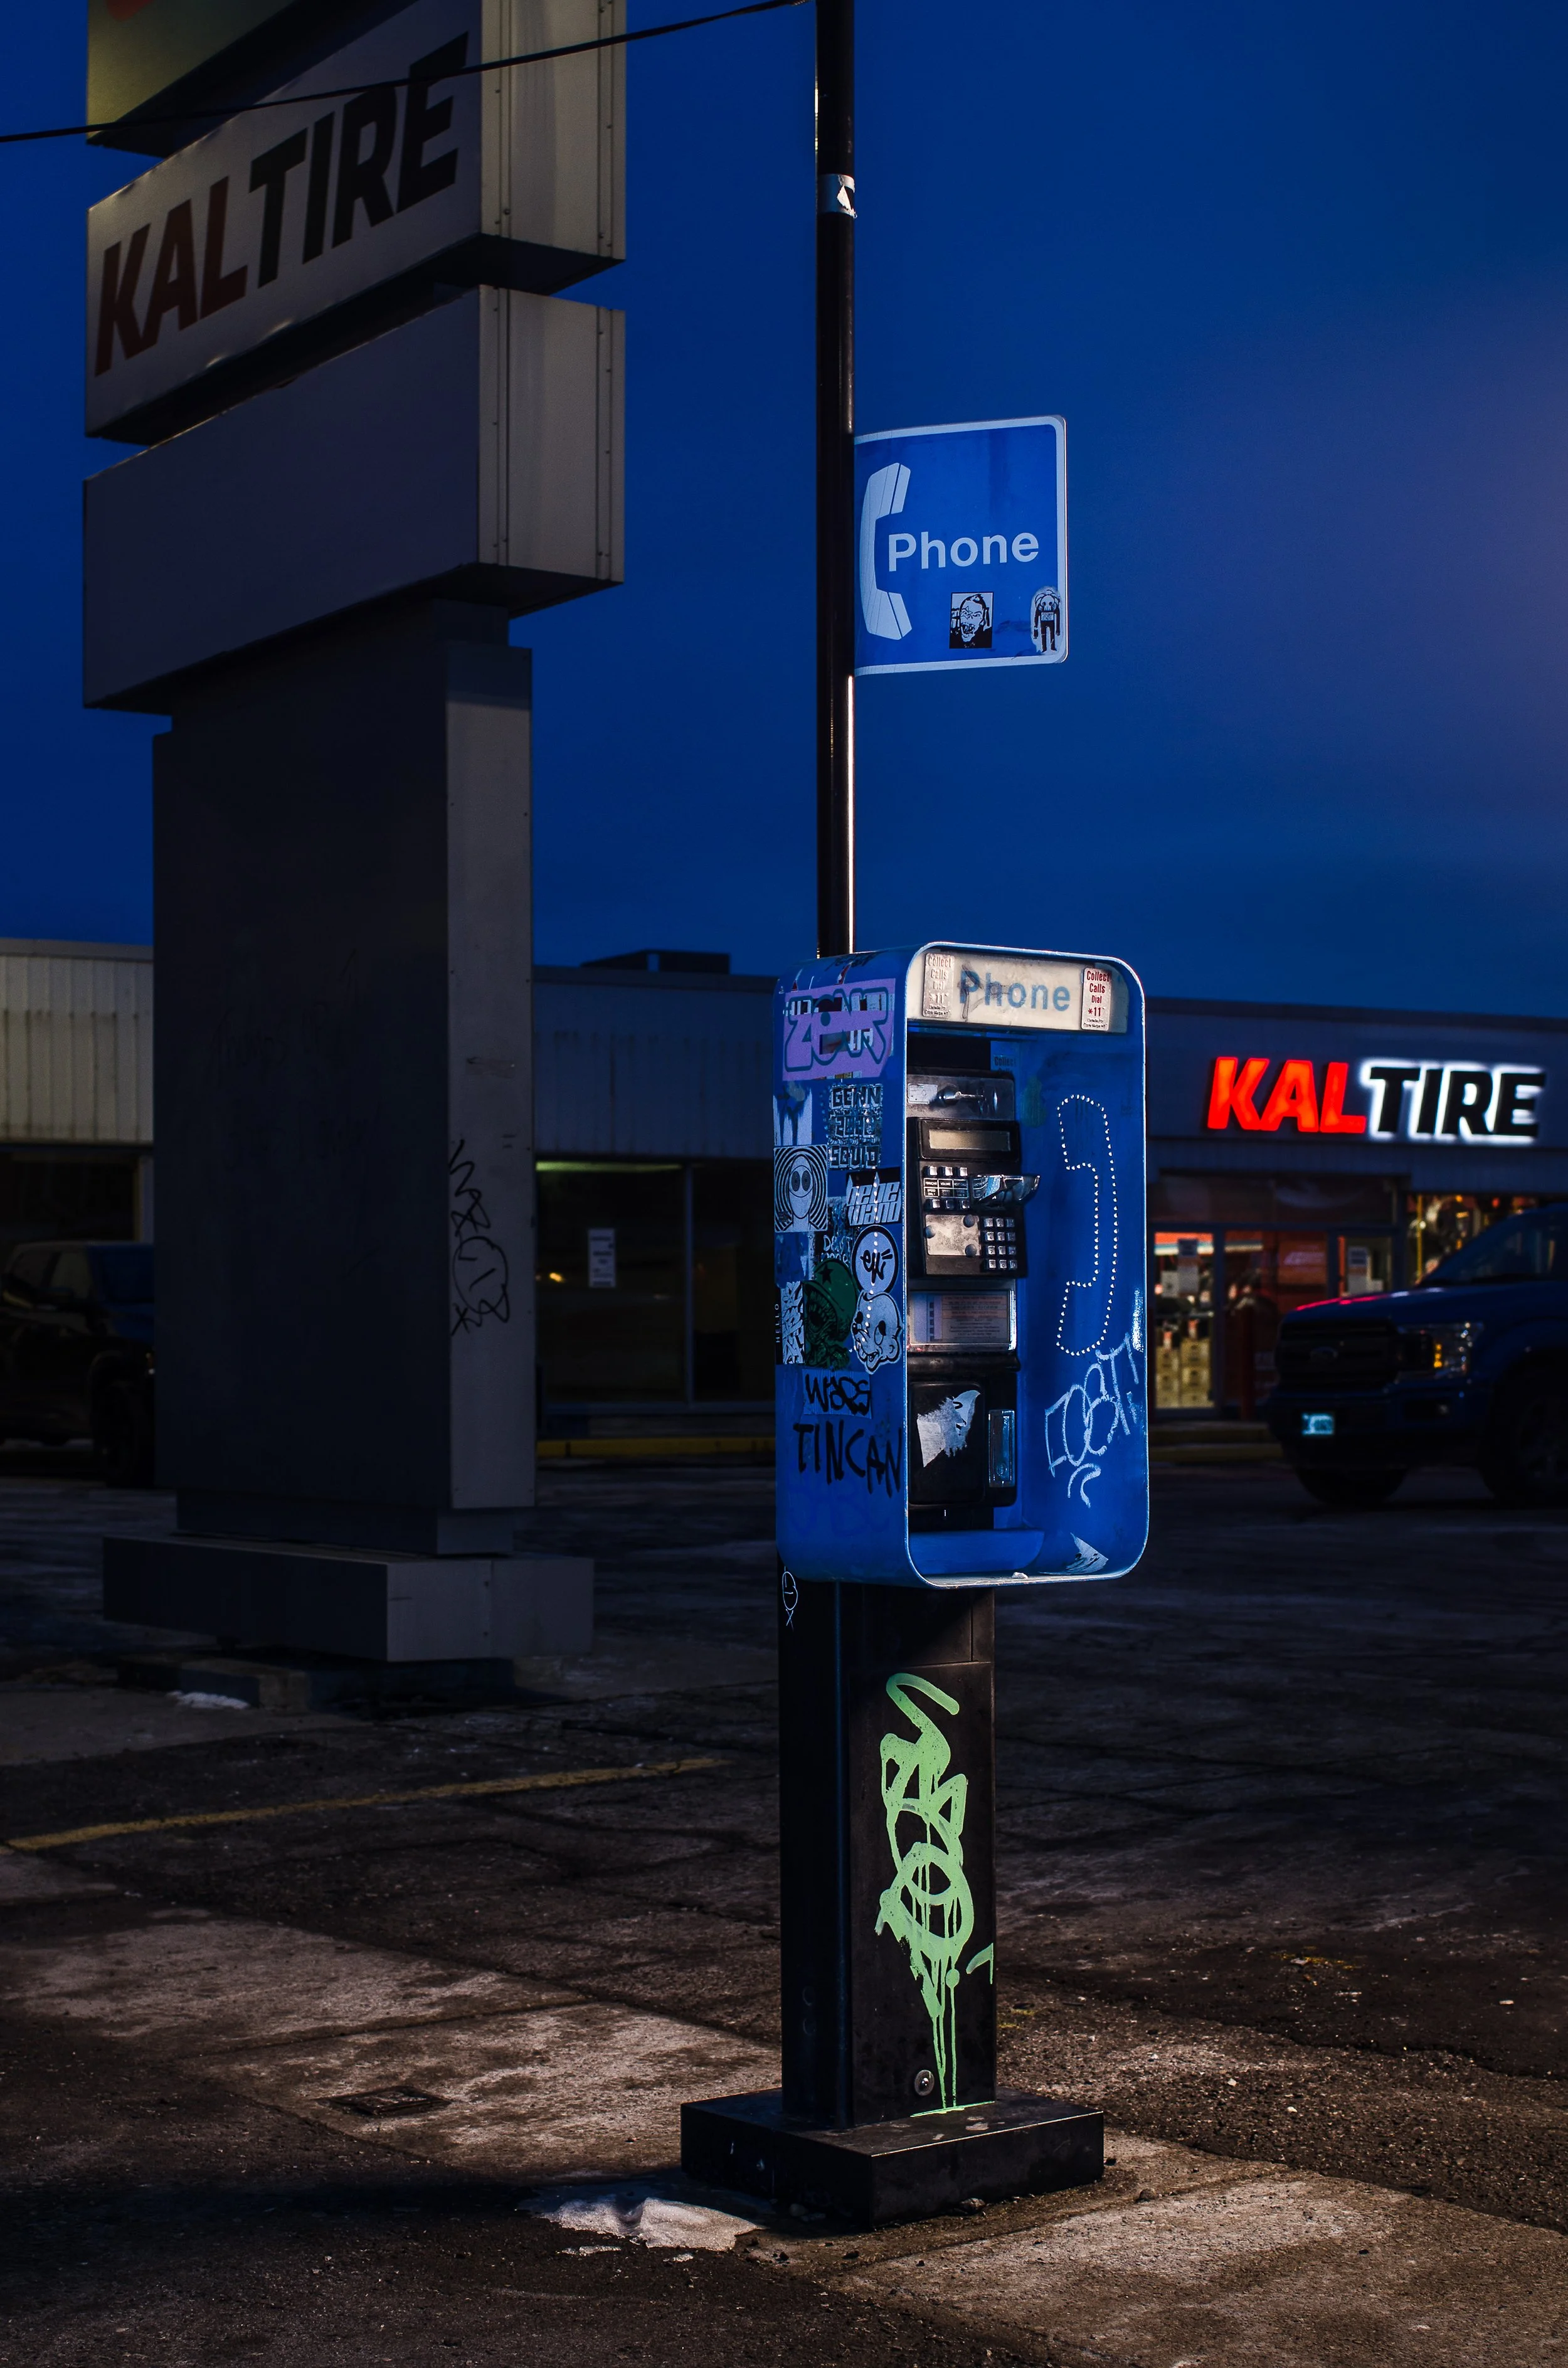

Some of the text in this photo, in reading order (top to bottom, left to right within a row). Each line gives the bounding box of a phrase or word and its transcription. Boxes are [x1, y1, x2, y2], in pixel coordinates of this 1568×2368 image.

[888, 531, 1039, 572] Phone
[928, 955, 951, 968] Collect
[931, 969, 948, 980] Calls
[1086, 970, 1110, 982] Collect
[960, 972, 1071, 1011] Phone
[1089, 983, 1106, 994] Calls
[1091, 995, 1102, 1004] Dial
[793, 1420, 903, 1499] TINCAN
